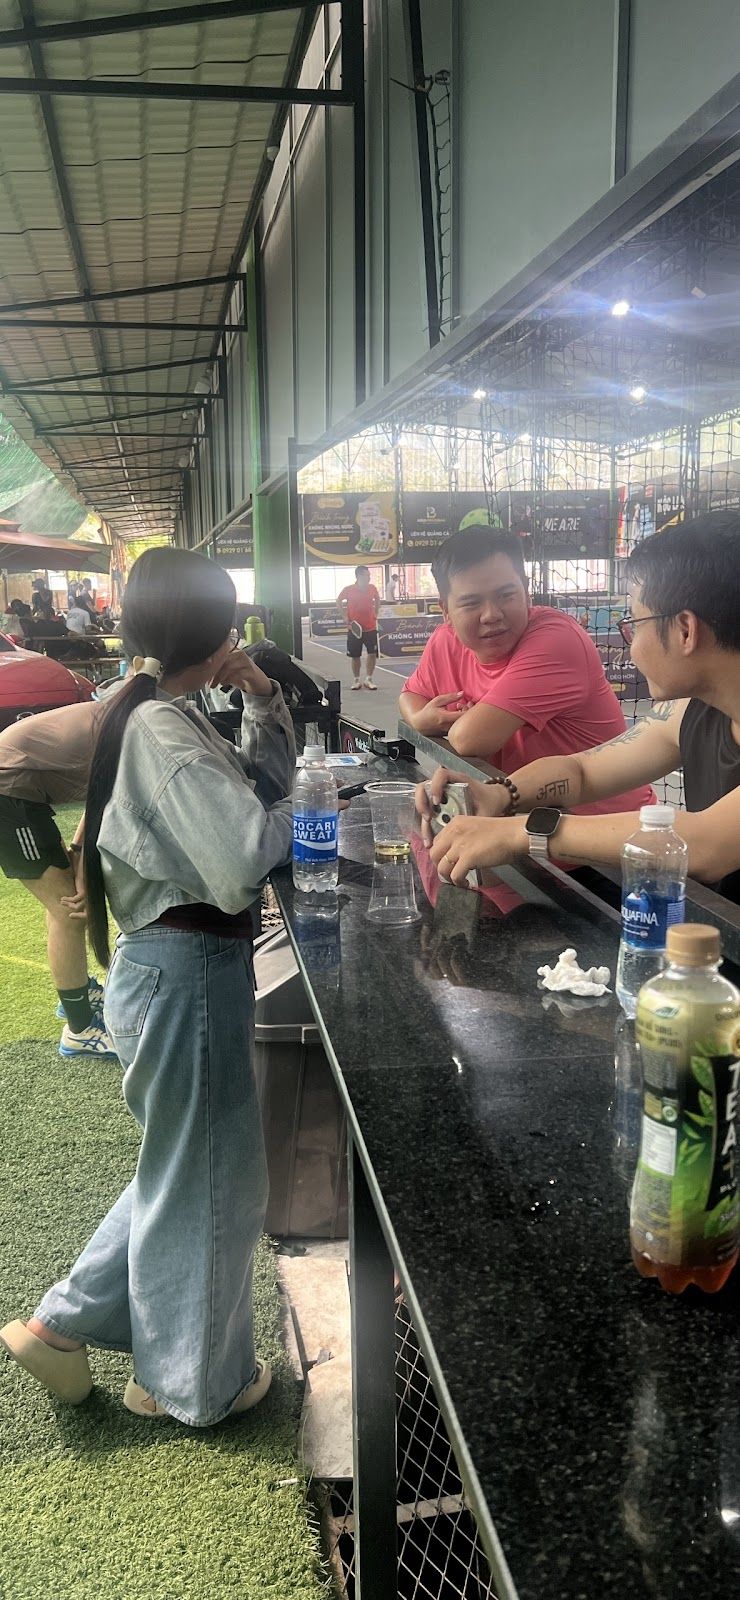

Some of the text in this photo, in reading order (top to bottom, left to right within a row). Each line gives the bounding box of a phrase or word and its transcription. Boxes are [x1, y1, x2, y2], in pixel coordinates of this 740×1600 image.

[388, 631, 433, 640] KHÔNG NHÚN
[293, 820, 336, 832] POCARI
[293, 829, 333, 840] SWEAT
